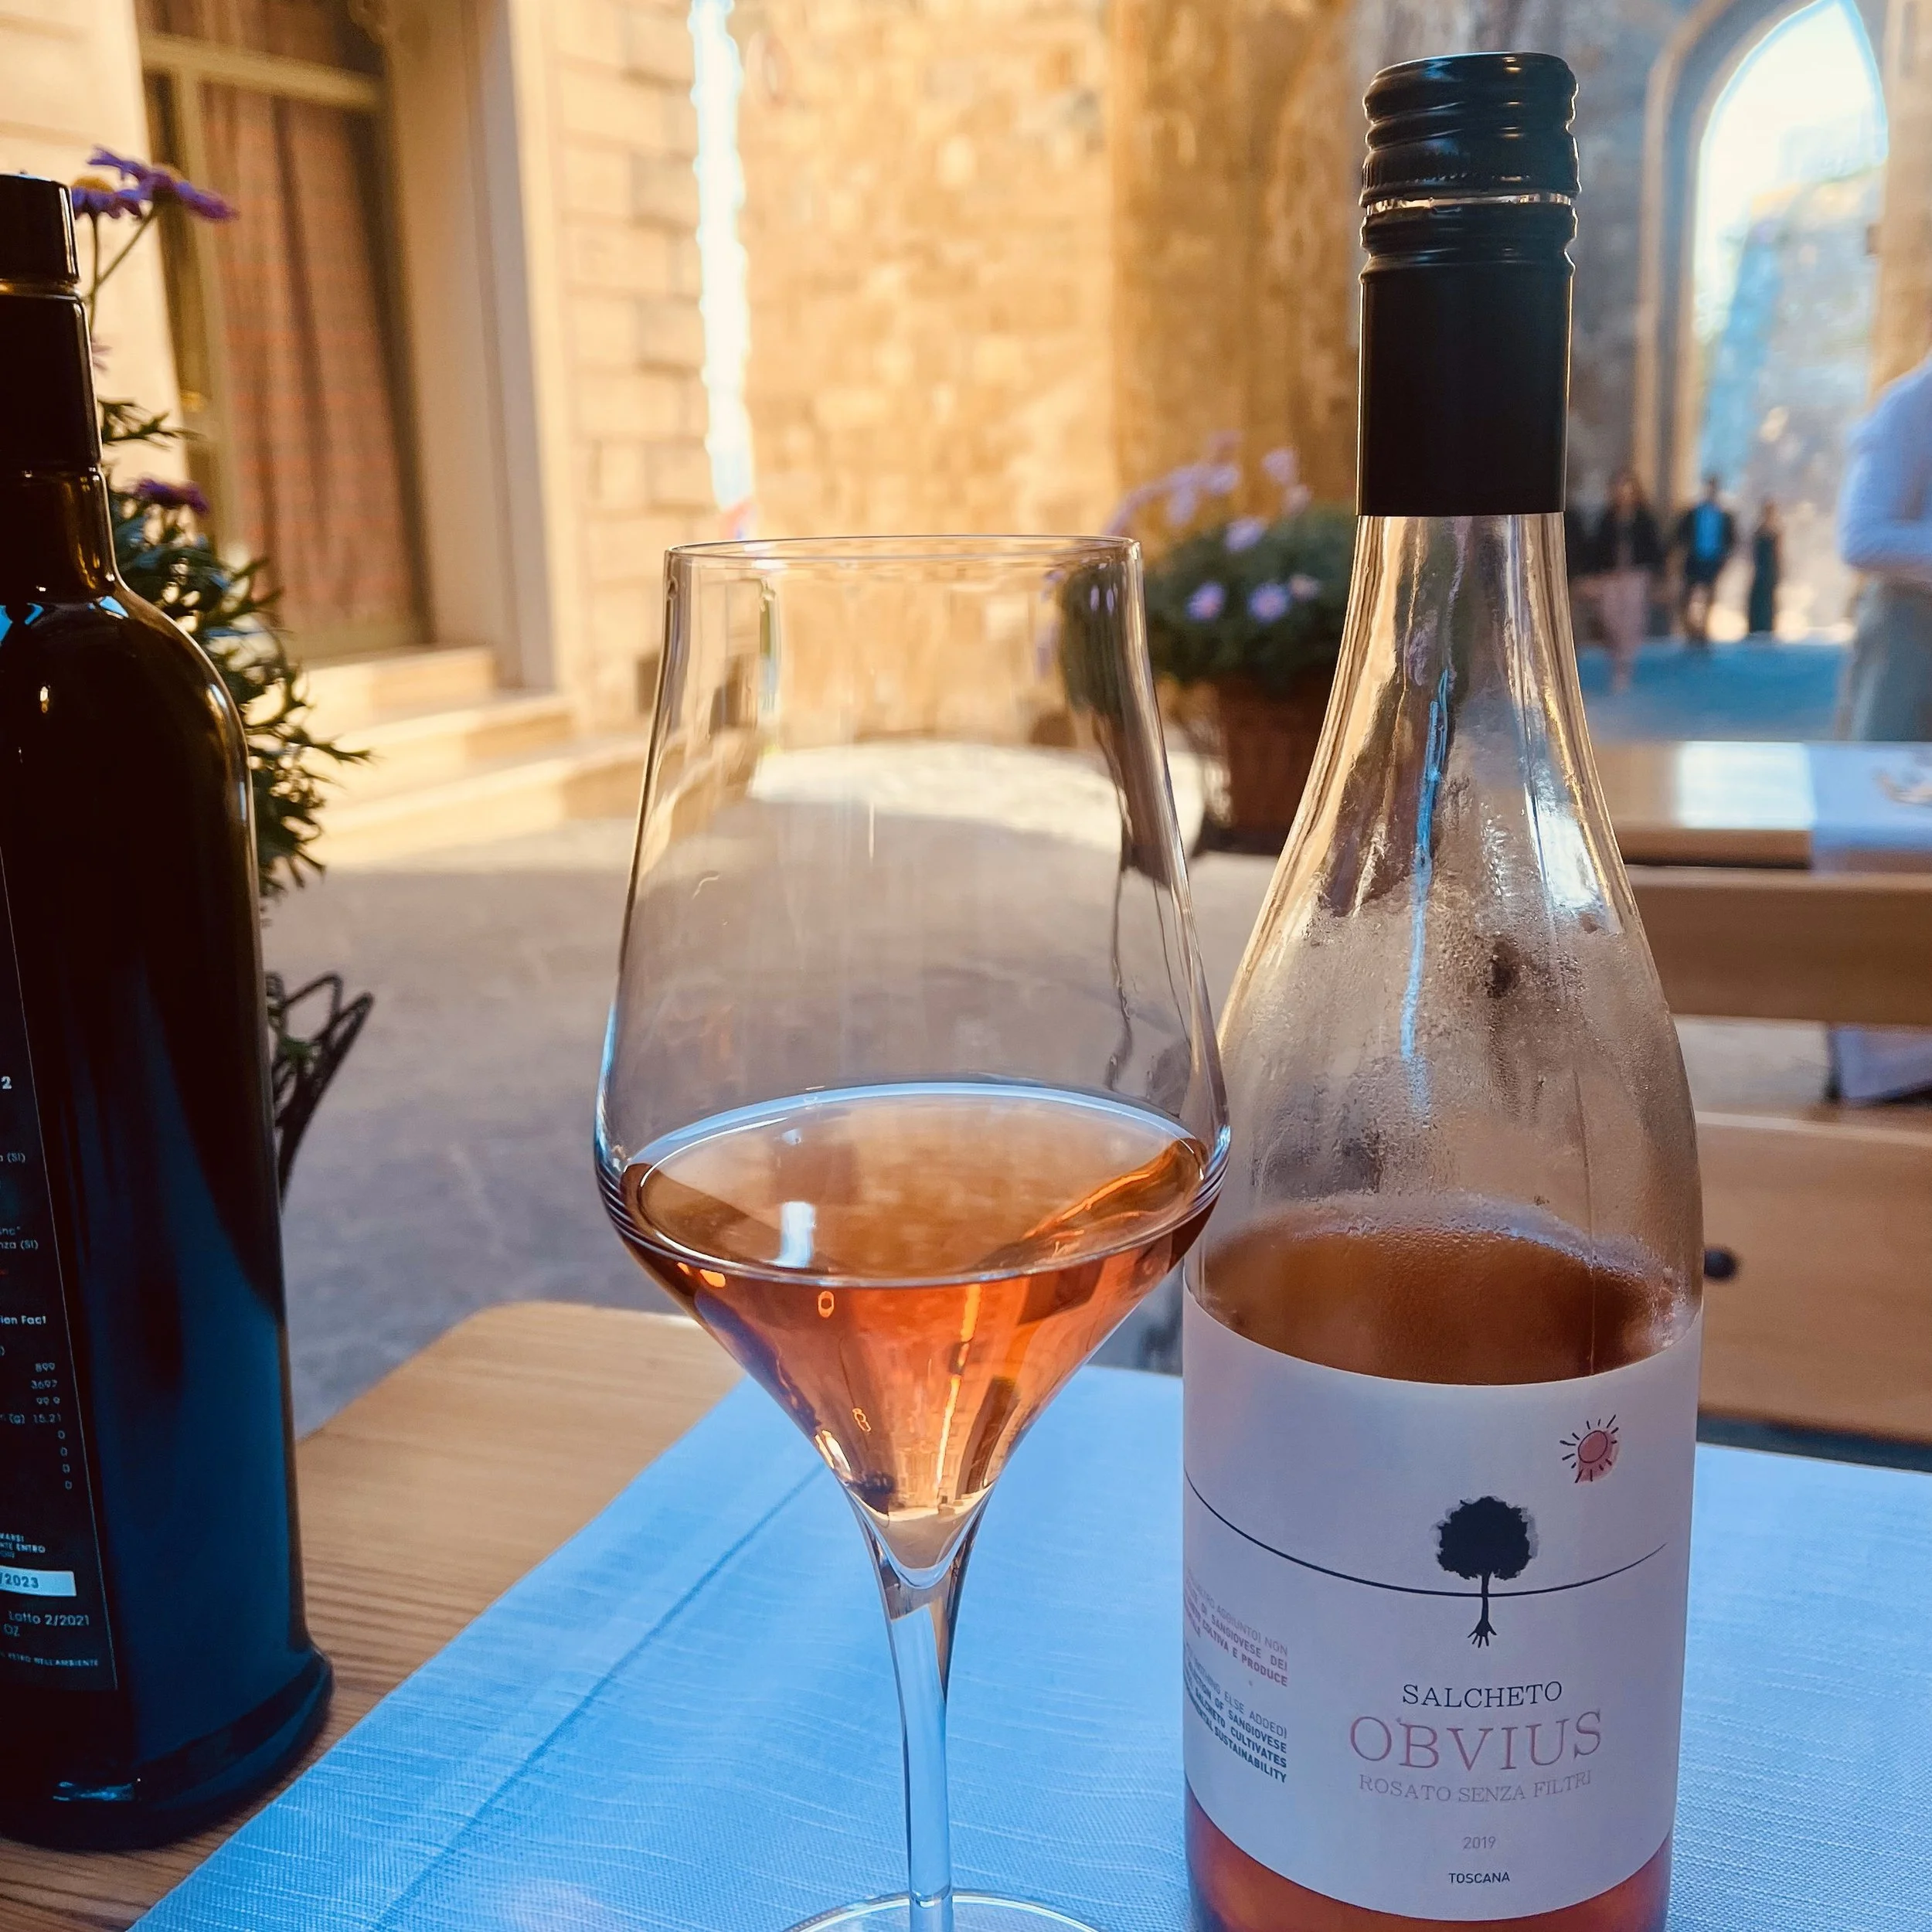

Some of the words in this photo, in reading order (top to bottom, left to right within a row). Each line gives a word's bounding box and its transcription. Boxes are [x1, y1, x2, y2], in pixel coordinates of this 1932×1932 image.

[1211, 1614, 1262, 1659] SANGIOVESE
[1270, 1655, 1288, 1672] DEI
[1265, 1636, 1288, 1656] NON
[1241, 1653, 1288, 1688] PRODUCE
[1224, 1690, 1245, 1714] ELSE
[1403, 1681, 1563, 1708] SALCHETO
[1228, 1709, 1287, 1754] SANGIOVESE
[1230, 1726, 1287, 1769] CULTIVATES
[1350, 1709, 1602, 1772] OBVIUS
[1214, 1726, 1287, 1784] SUSTAINABILITY
[1359, 1774, 1452, 1802] ROSATO
[1458, 1784, 1526, 1803] SENZA
[1533, 1769, 1592, 1798] FILTRI
[1463, 1835, 1497, 1850] 2019
[1448, 1872, 1511, 1884] TOSCANA
